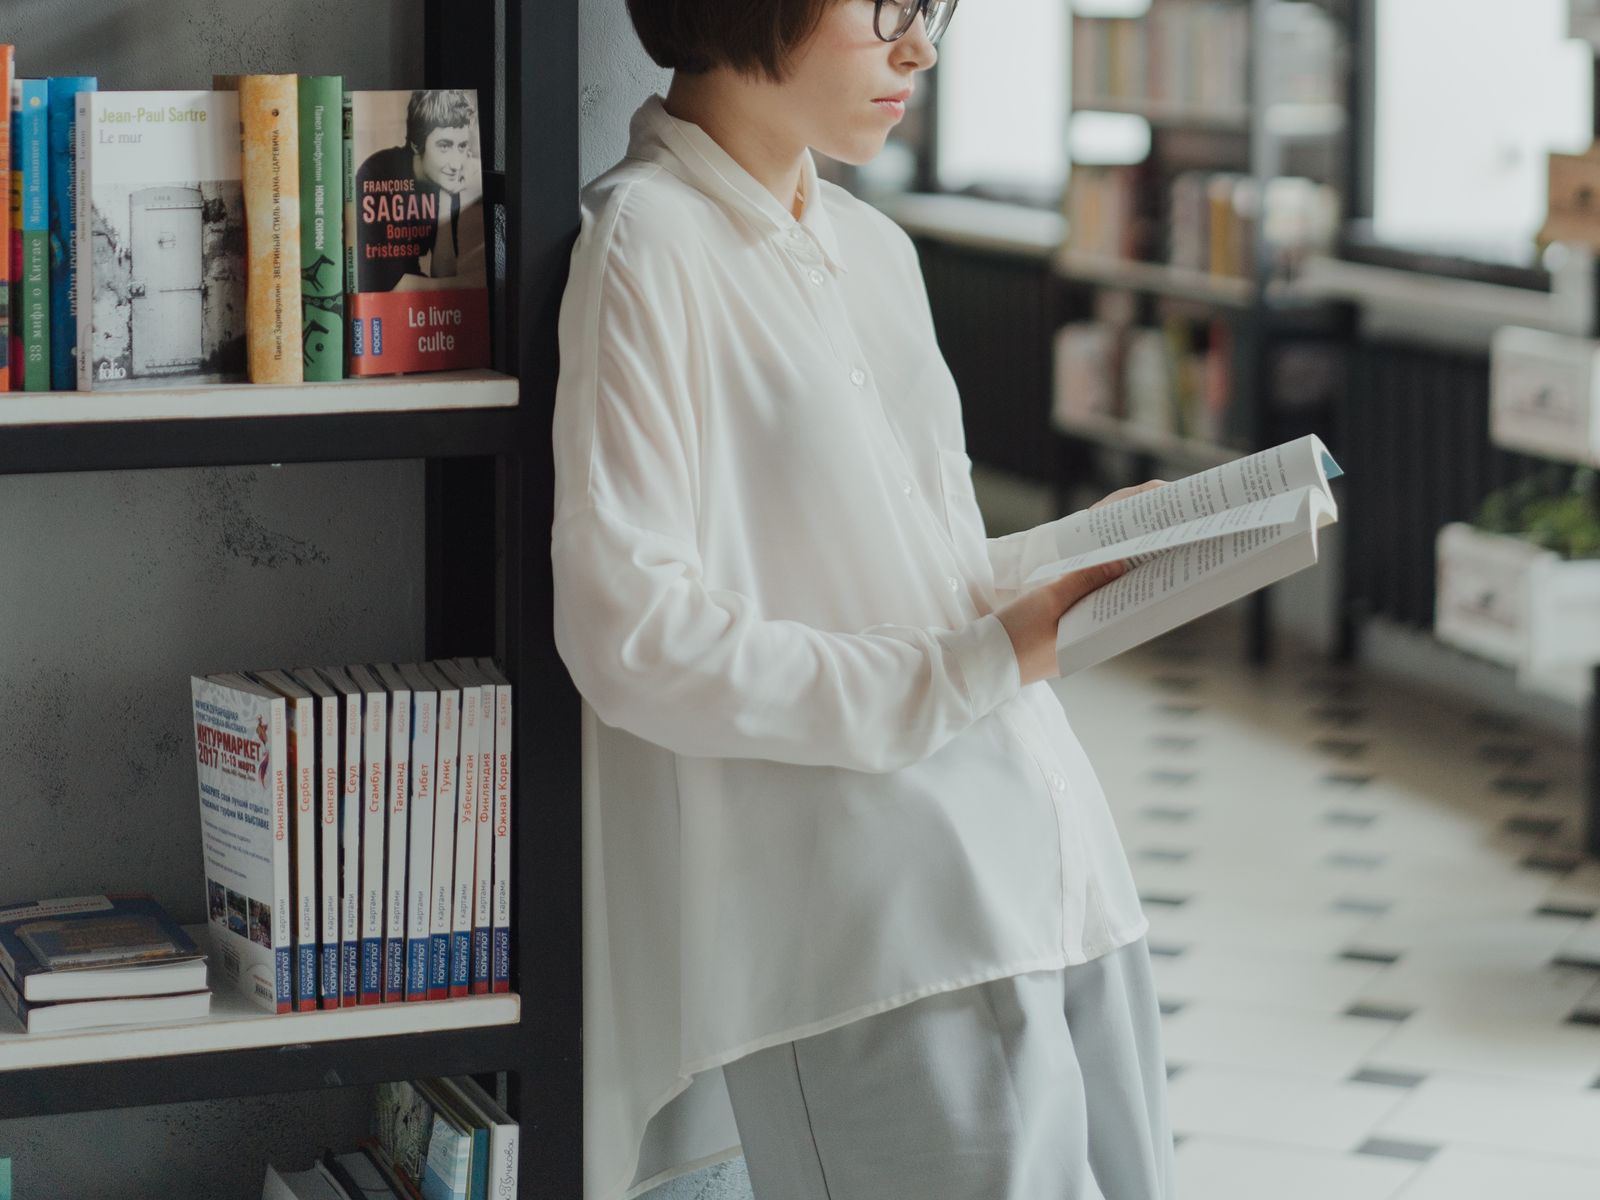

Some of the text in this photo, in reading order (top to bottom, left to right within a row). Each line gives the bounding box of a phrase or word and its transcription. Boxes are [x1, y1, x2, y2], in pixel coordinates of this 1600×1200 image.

[99, 107, 165, 123] Jean-Paul
[168, 106, 207, 122] Sartre
[315, 105, 324, 130] Павел
[99, 129, 143, 144] Le mur
[272, 130, 281, 203] ИВАНА-ЦАРЕВИЧА
[315, 185, 324, 215] НОВЫЕ
[363, 179, 415, 195] FRANÇOISE
[272, 204, 281, 233] СТИЛЬ
[362, 192, 436, 224] SAGAN
[315, 218, 324, 250] СКИФЫ
[386, 223, 431, 240] Bonjour
[272, 234, 281, 280] ЗВЕРИНЫЙ
[366, 243, 420, 259] tristesse
[29, 238, 44, 361] 33 мифа о Китае
[408, 306, 462, 327] Le livre
[273, 336, 282, 360] Павел
[418, 332, 455, 353] culte
[98, 360, 127, 379] folio
[197, 723, 261, 761] ИНТУРМАРКЕТ
[199, 743, 256, 773] 2017 11-13 марта
[301, 767, 311, 812] Сербия
[347, 765, 359, 794] Сеул
[370, 762, 381, 812] Стамбул
[394, 762, 406, 814] Таиланд
[418, 763, 429, 800] Тибет
[441, 758, 451, 794] Тунис
[462, 754, 473, 823] Узбекистан
[480, 753, 491, 823] Финляндия
[276, 770, 285, 841] Финляндия
[325, 767, 336, 825] Сингапур
[498, 753, 509, 837] Южная Корея
[237, 811, 243, 821] НА
[245, 814, 270, 830] ВЫСТАВКЕ
[304, 896, 312, 930] картами
[328, 896, 336, 927] картами
[348, 893, 356, 928] картами
[370, 890, 378, 925] картами
[438, 938, 446, 983] ПОЛИГЛОТ
[499, 1138, 515, 1196] Пучкова
